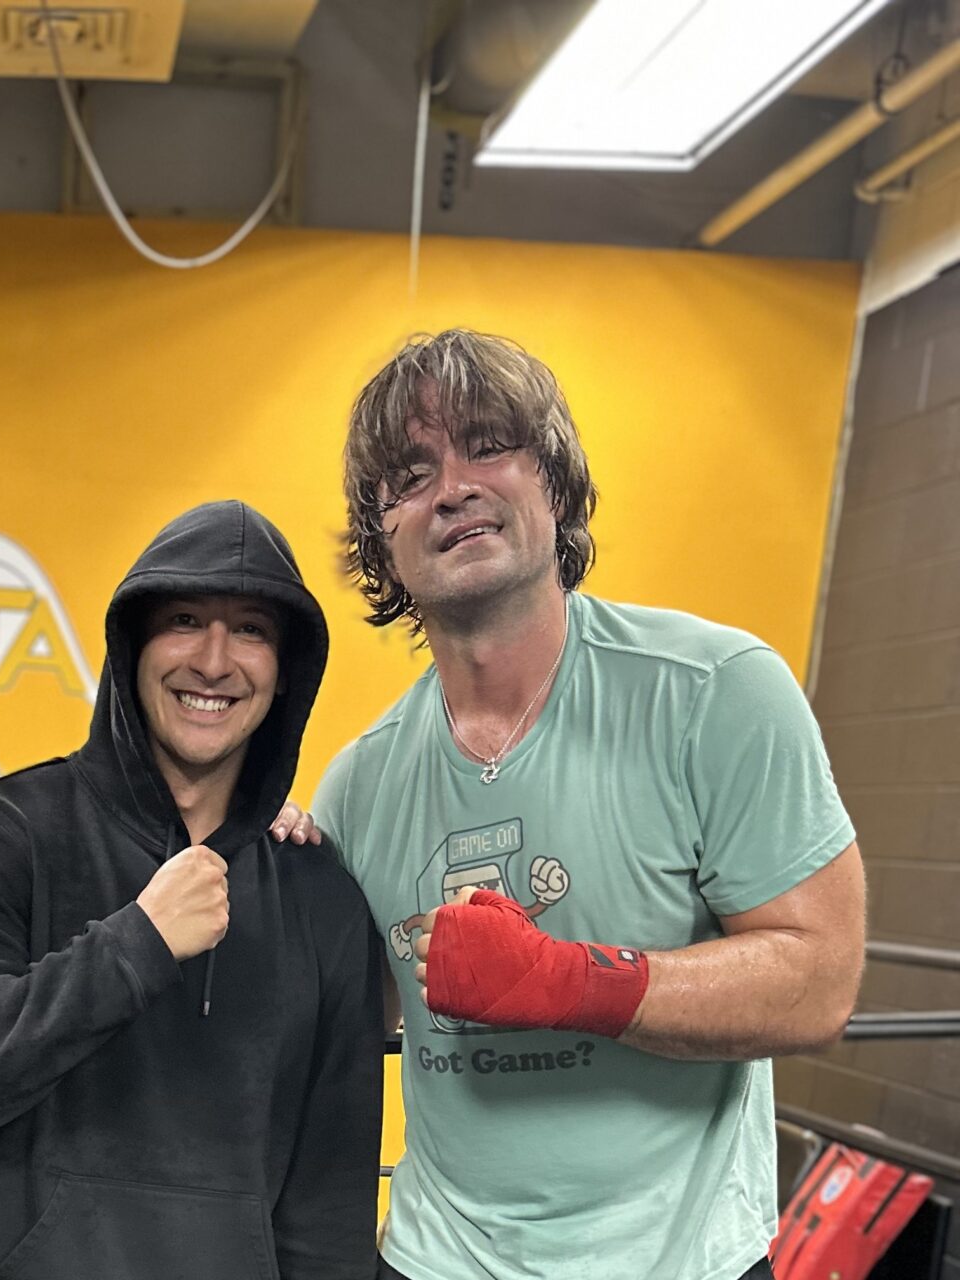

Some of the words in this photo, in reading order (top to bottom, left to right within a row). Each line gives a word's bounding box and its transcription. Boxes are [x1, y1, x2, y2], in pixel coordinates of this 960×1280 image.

[451, 831, 492, 859] GAME
[497, 825, 518, 848] ON
[418, 1045, 464, 1075] Got
[471, 1041, 596, 1075] Game?
